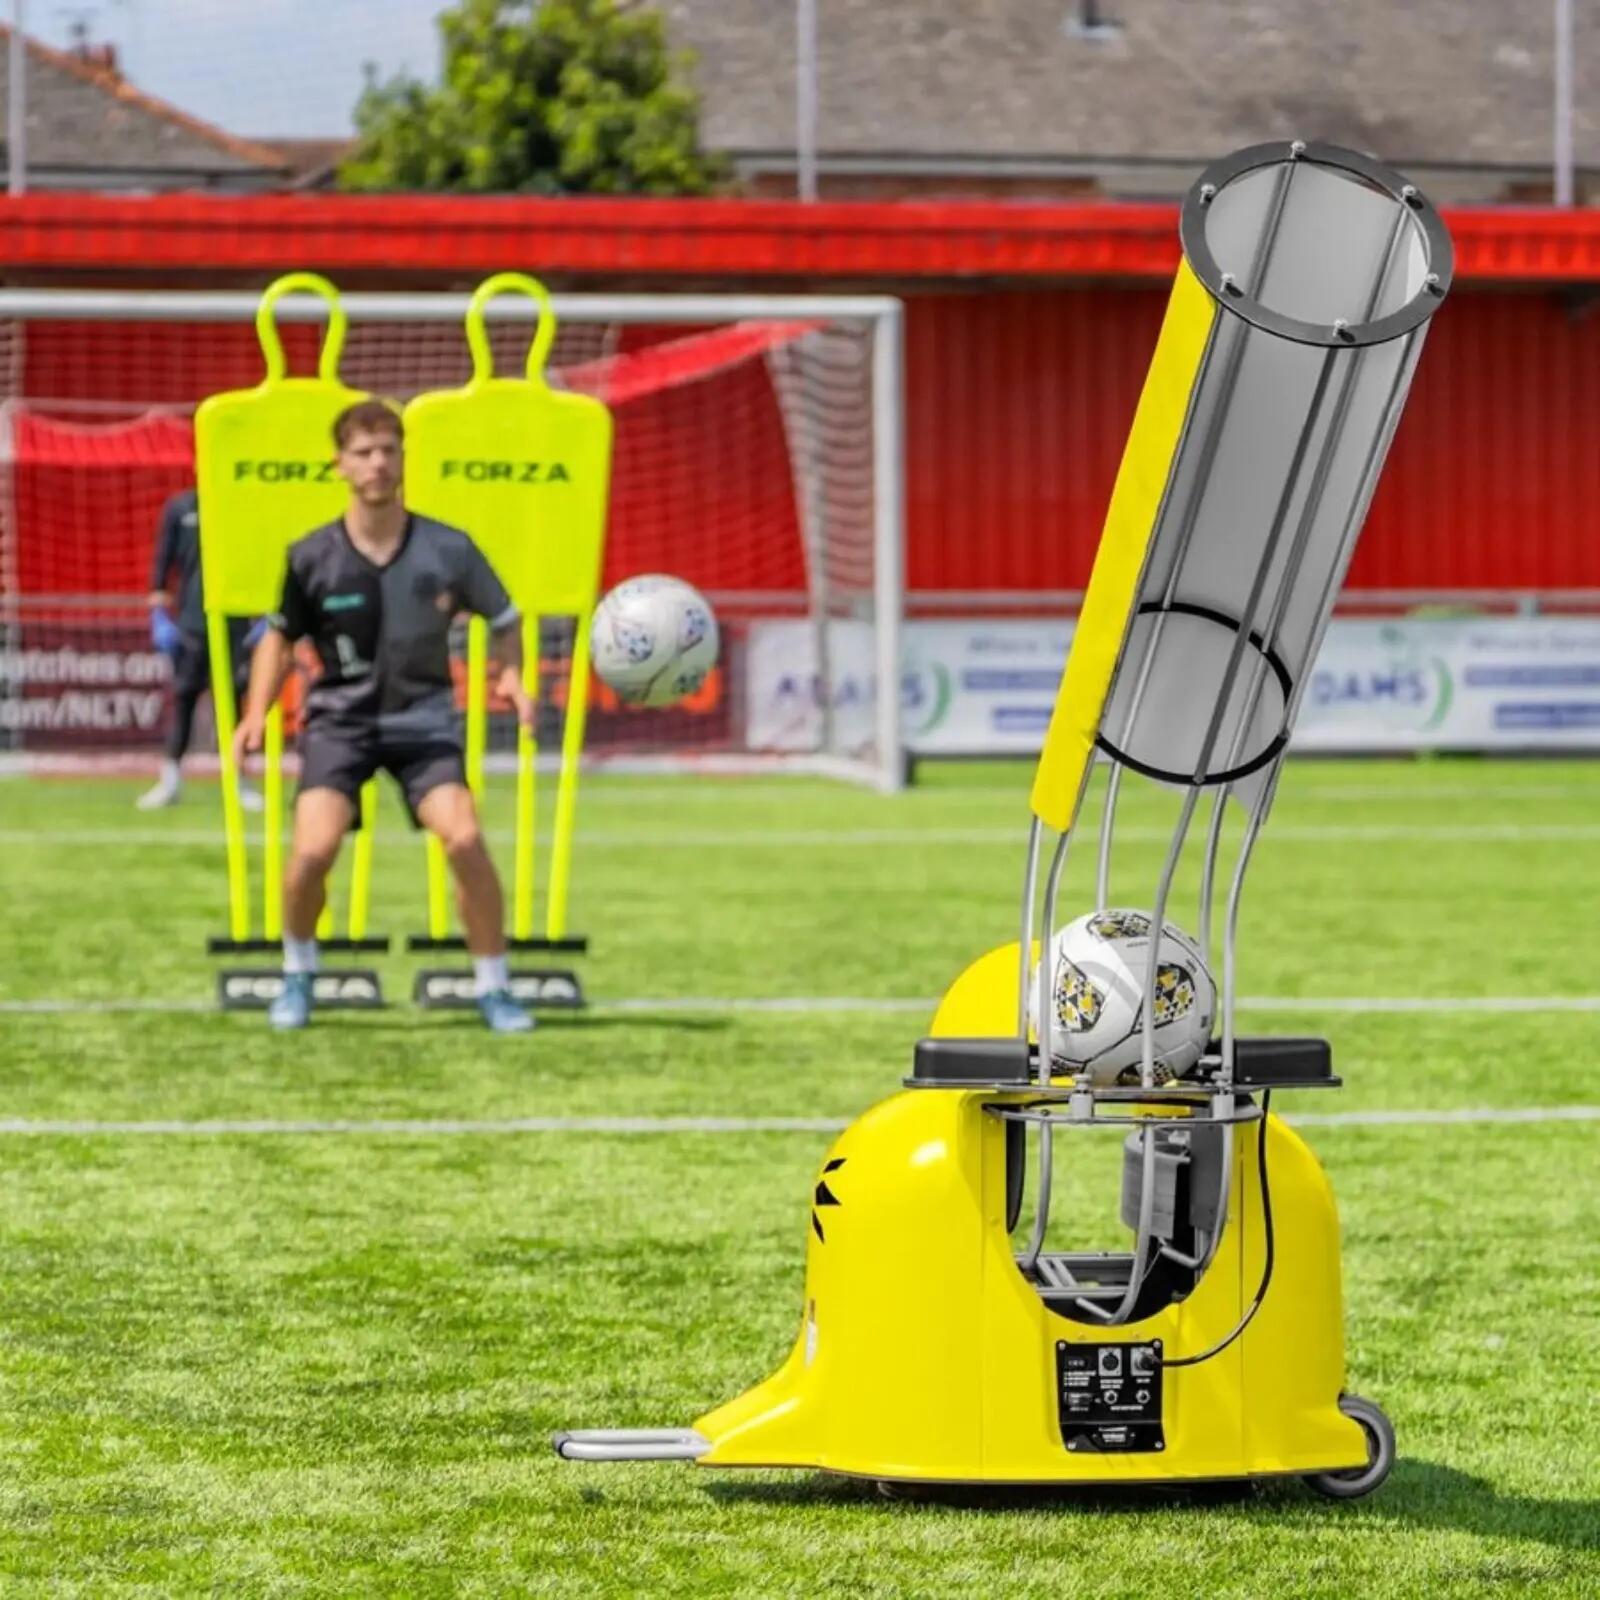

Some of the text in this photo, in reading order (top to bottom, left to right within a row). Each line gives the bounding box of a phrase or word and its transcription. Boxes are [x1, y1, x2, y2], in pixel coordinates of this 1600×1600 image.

[234, 460, 336, 482] FORZ
[440, 460, 570, 482] FORZA
[1310, 668, 1427, 706] DAMS
